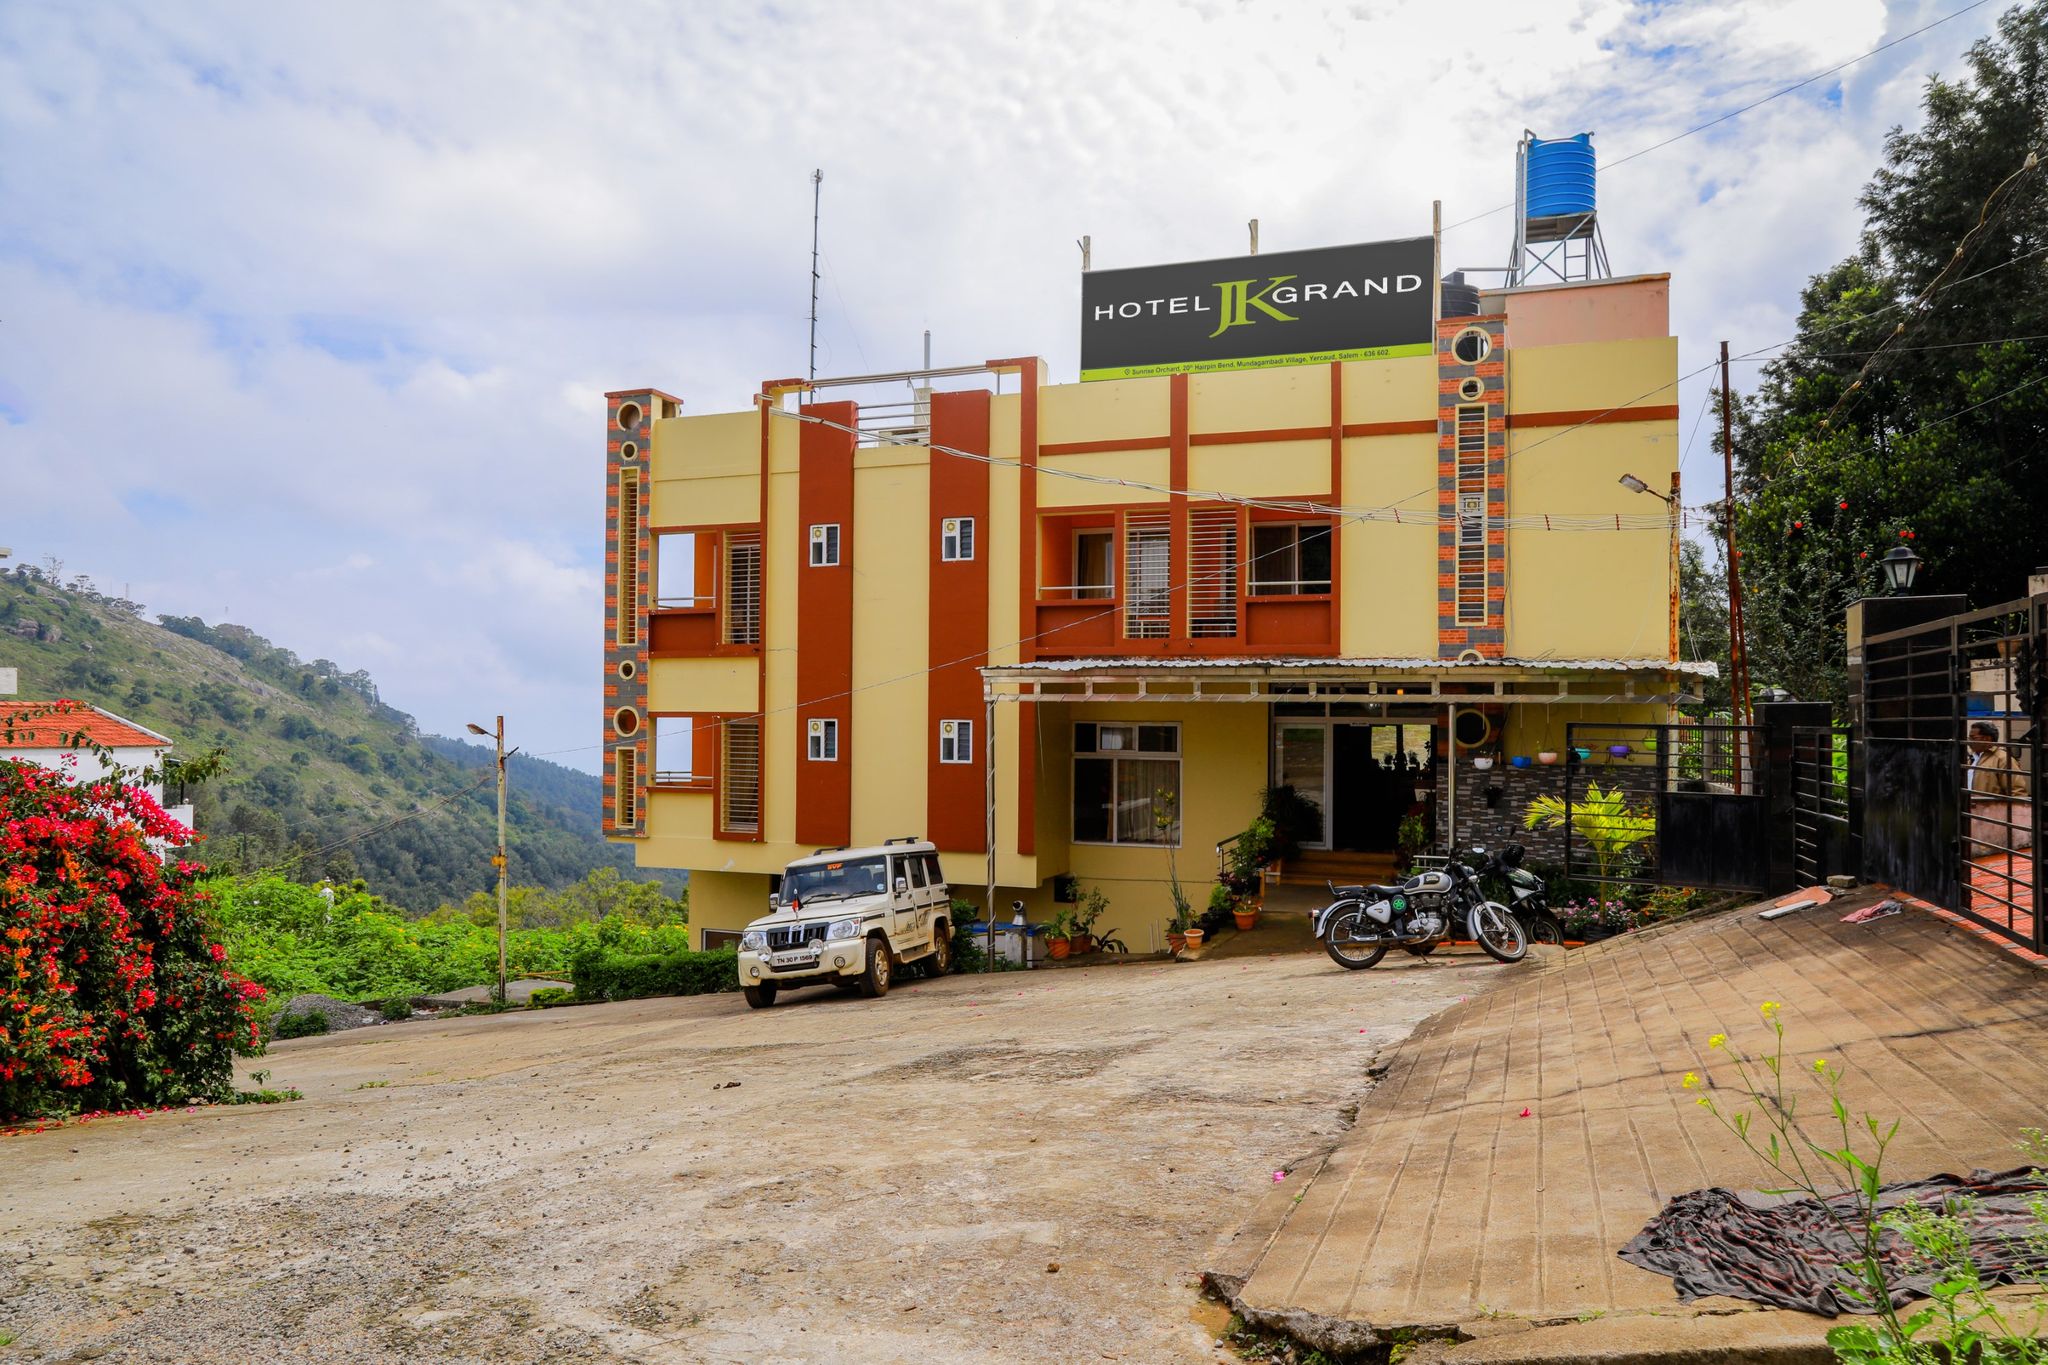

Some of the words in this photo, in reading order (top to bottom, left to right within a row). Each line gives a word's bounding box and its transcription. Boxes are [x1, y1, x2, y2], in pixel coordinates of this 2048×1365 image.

[1095, 296, 1210, 320] HOTEL
[1209, 275, 1299, 338] JK
[1272, 275, 1422, 303] GRAND
[1195, 363, 1216, 371] Hairpin
